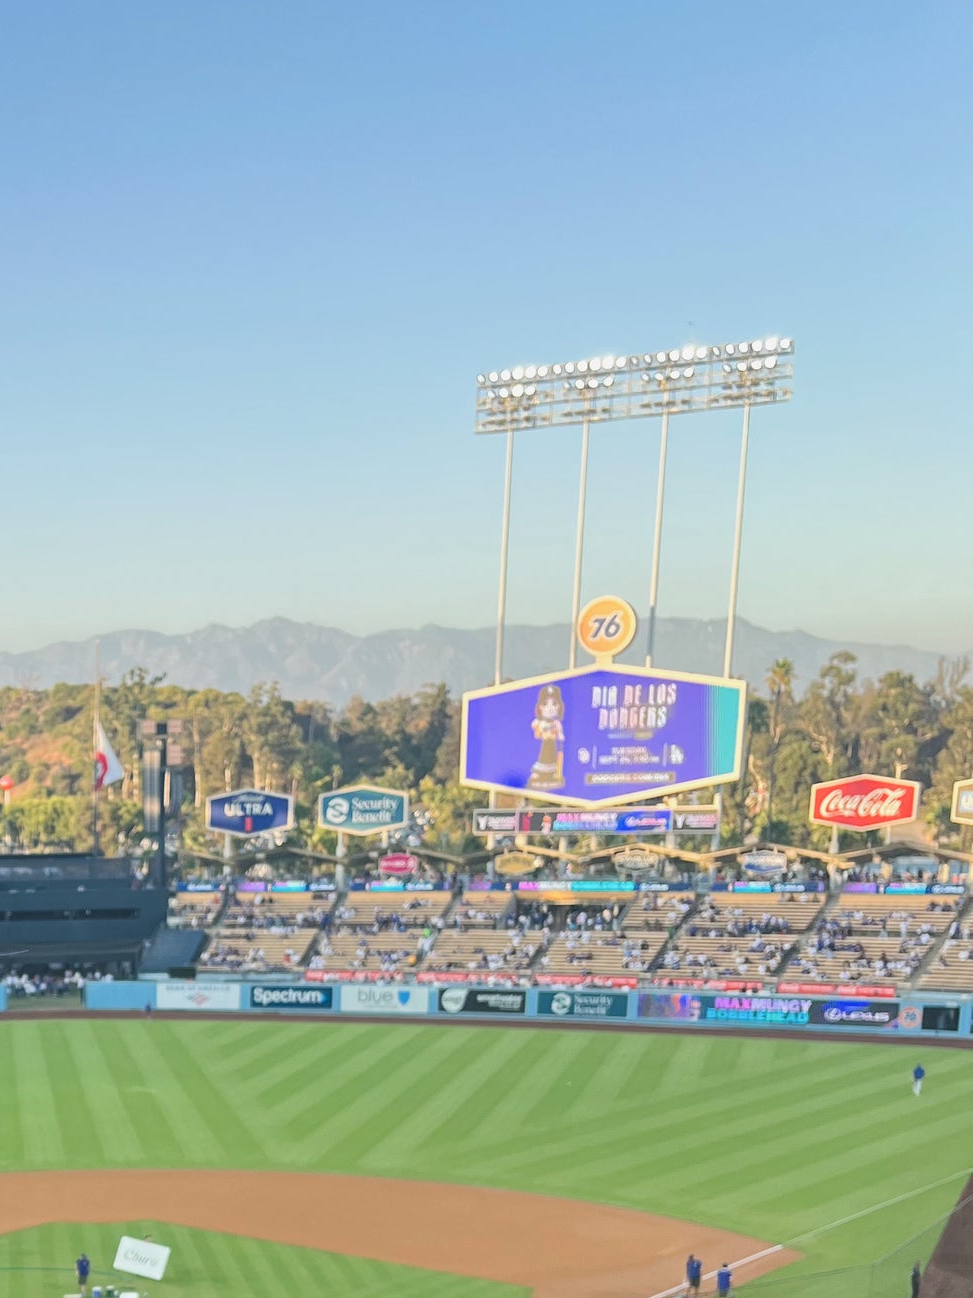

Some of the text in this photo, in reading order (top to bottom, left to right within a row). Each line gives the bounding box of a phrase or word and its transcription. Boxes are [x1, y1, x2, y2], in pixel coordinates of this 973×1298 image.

[590, 613, 621, 639] 76
[223, 801, 274, 817] ULTRA
[351, 797, 400, 813] Security
[351, 810, 392, 824] Benefit
[253, 986, 322, 1006] Spectrum
[357, 988, 393, 1003] blue
[573, 994, 613, 1007] Security
[573, 1005, 607, 1015] Benefit
[841, 1011, 890, 1023] LEXUS
